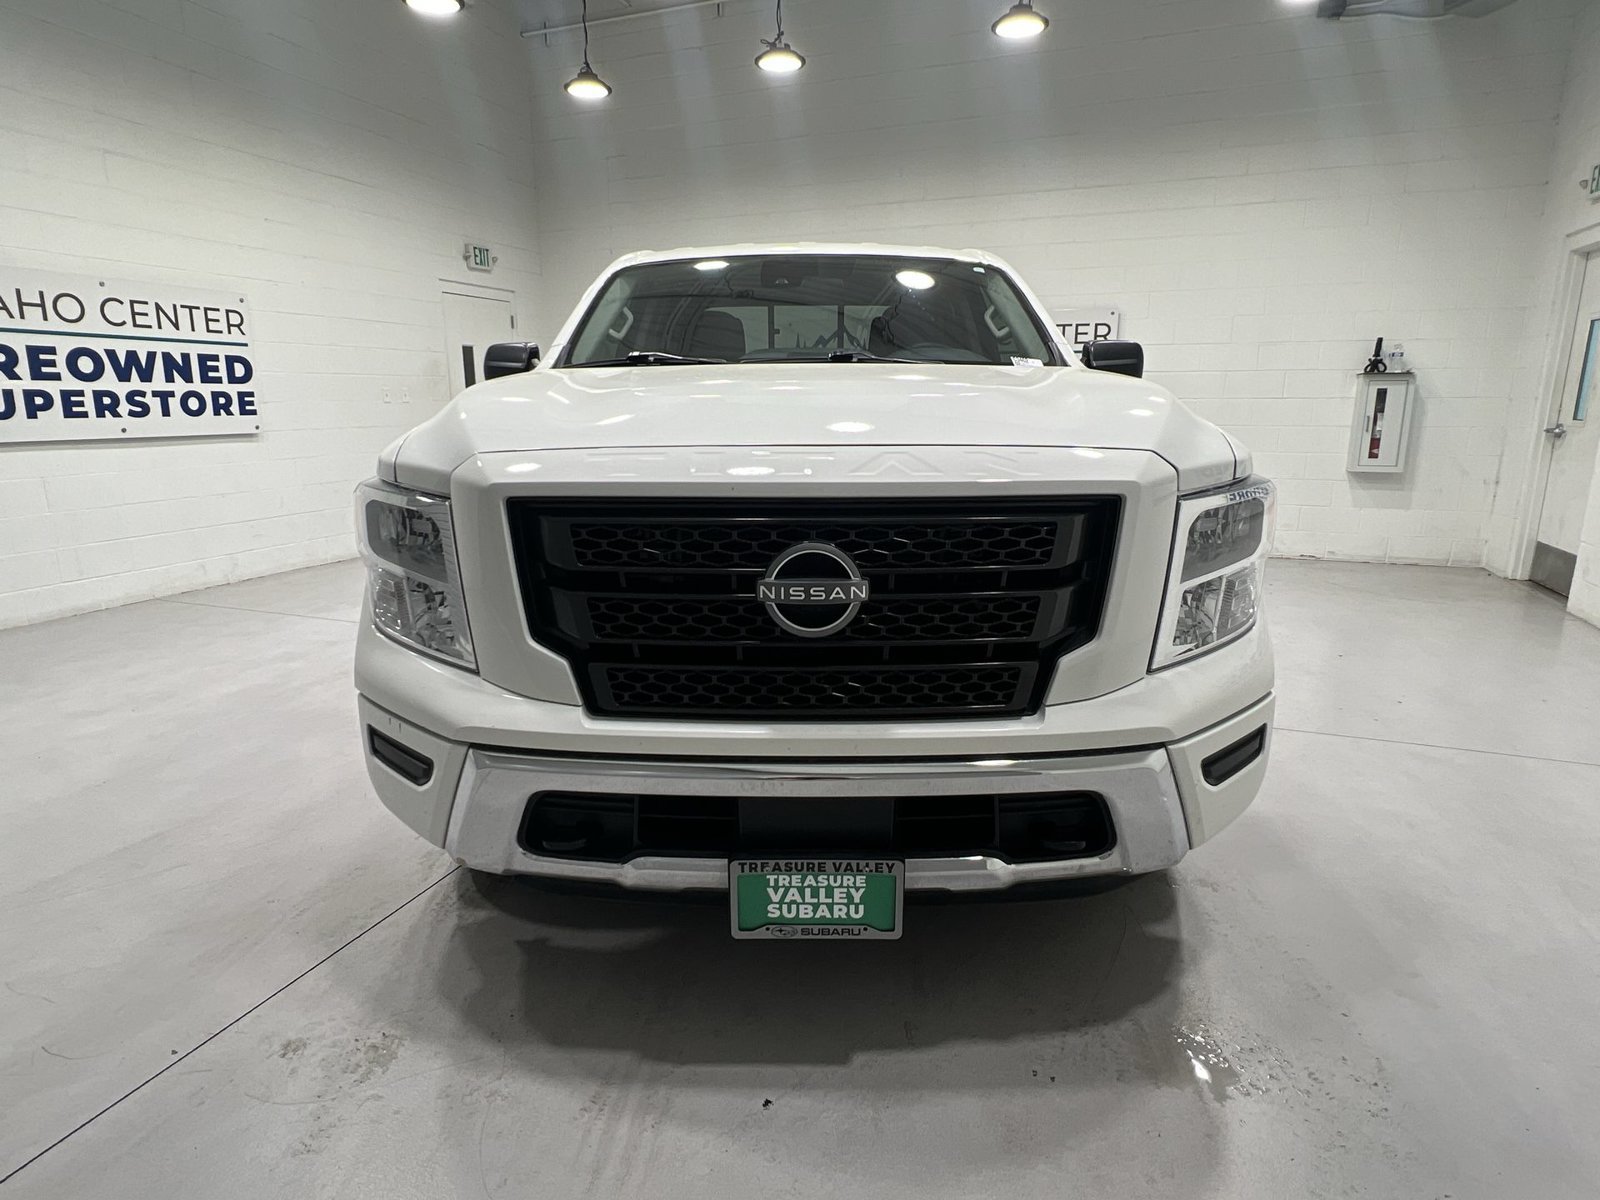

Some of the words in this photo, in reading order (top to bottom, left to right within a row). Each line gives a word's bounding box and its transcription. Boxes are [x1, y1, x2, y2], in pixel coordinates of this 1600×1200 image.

[473, 246, 489, 267] EXIT
[100, 297, 246, 335] CENTER
[760, 585, 866, 600] NISSAN
[738, 862, 827, 873] TREASURE
[832, 862, 895, 873] VALLEY
[766, 875, 867, 887] TREASURE
[766, 887, 866, 903] VALLEY
[767, 904, 865, 919] SUBARU
[801, 928, 861, 936] SUBARU
